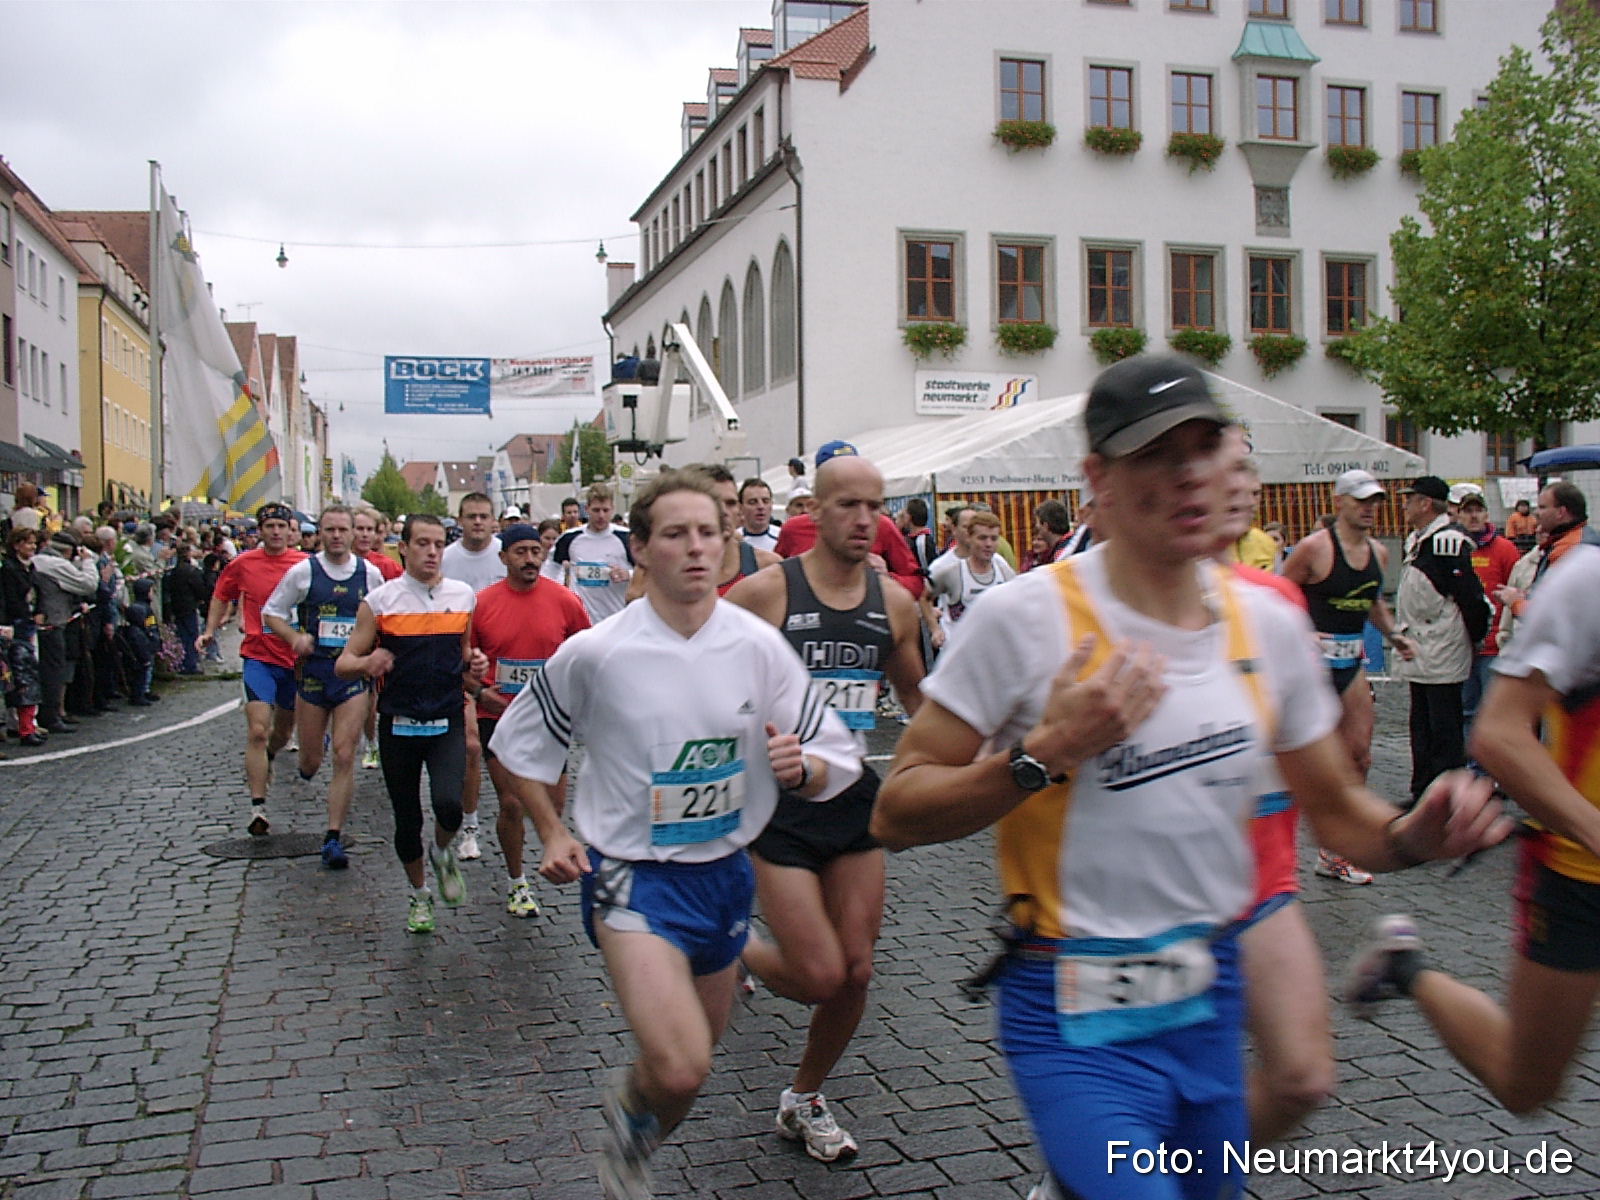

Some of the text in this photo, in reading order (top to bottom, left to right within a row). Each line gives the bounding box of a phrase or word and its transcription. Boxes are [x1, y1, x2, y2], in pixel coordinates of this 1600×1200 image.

[390, 359, 484, 380] BOCK
[925, 379, 990, 391] stadtwerke
[923, 392, 978, 403] neumarkt
[1303, 463, 1325, 475] Tel:
[587, 567, 601, 578] 28
[802, 641, 878, 671] HDI
[681, 780, 731, 819] 221
